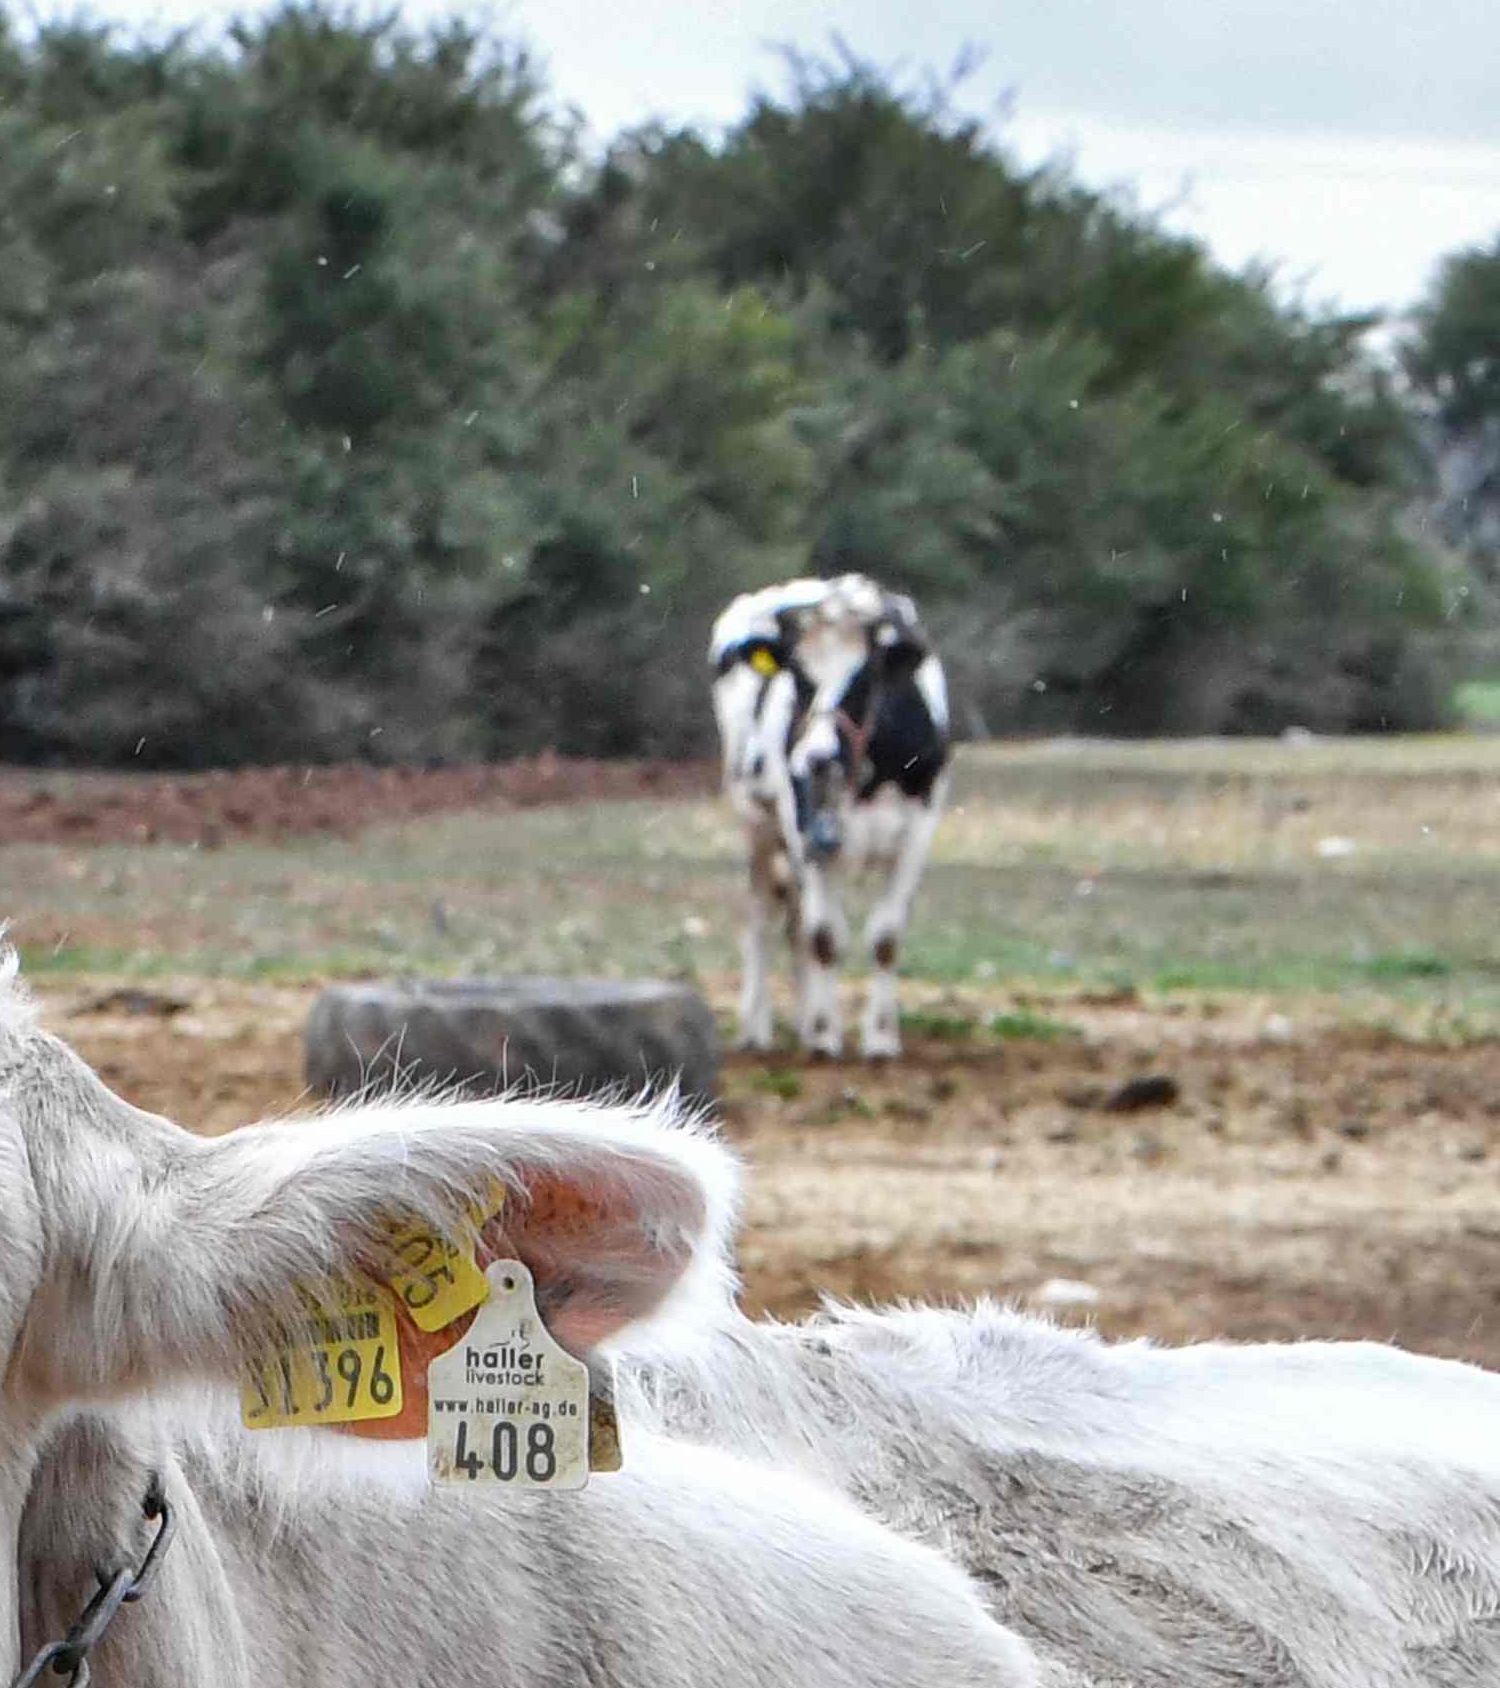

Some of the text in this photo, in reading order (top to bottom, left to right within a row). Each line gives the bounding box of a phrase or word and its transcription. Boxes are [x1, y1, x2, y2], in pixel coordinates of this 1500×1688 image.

[465, 1346, 545, 1369] haller
[465, 1370, 545, 1386] livestock
[434, 1398, 578, 1419] www.haller-ag.de
[455, 1419, 557, 1482] 408
